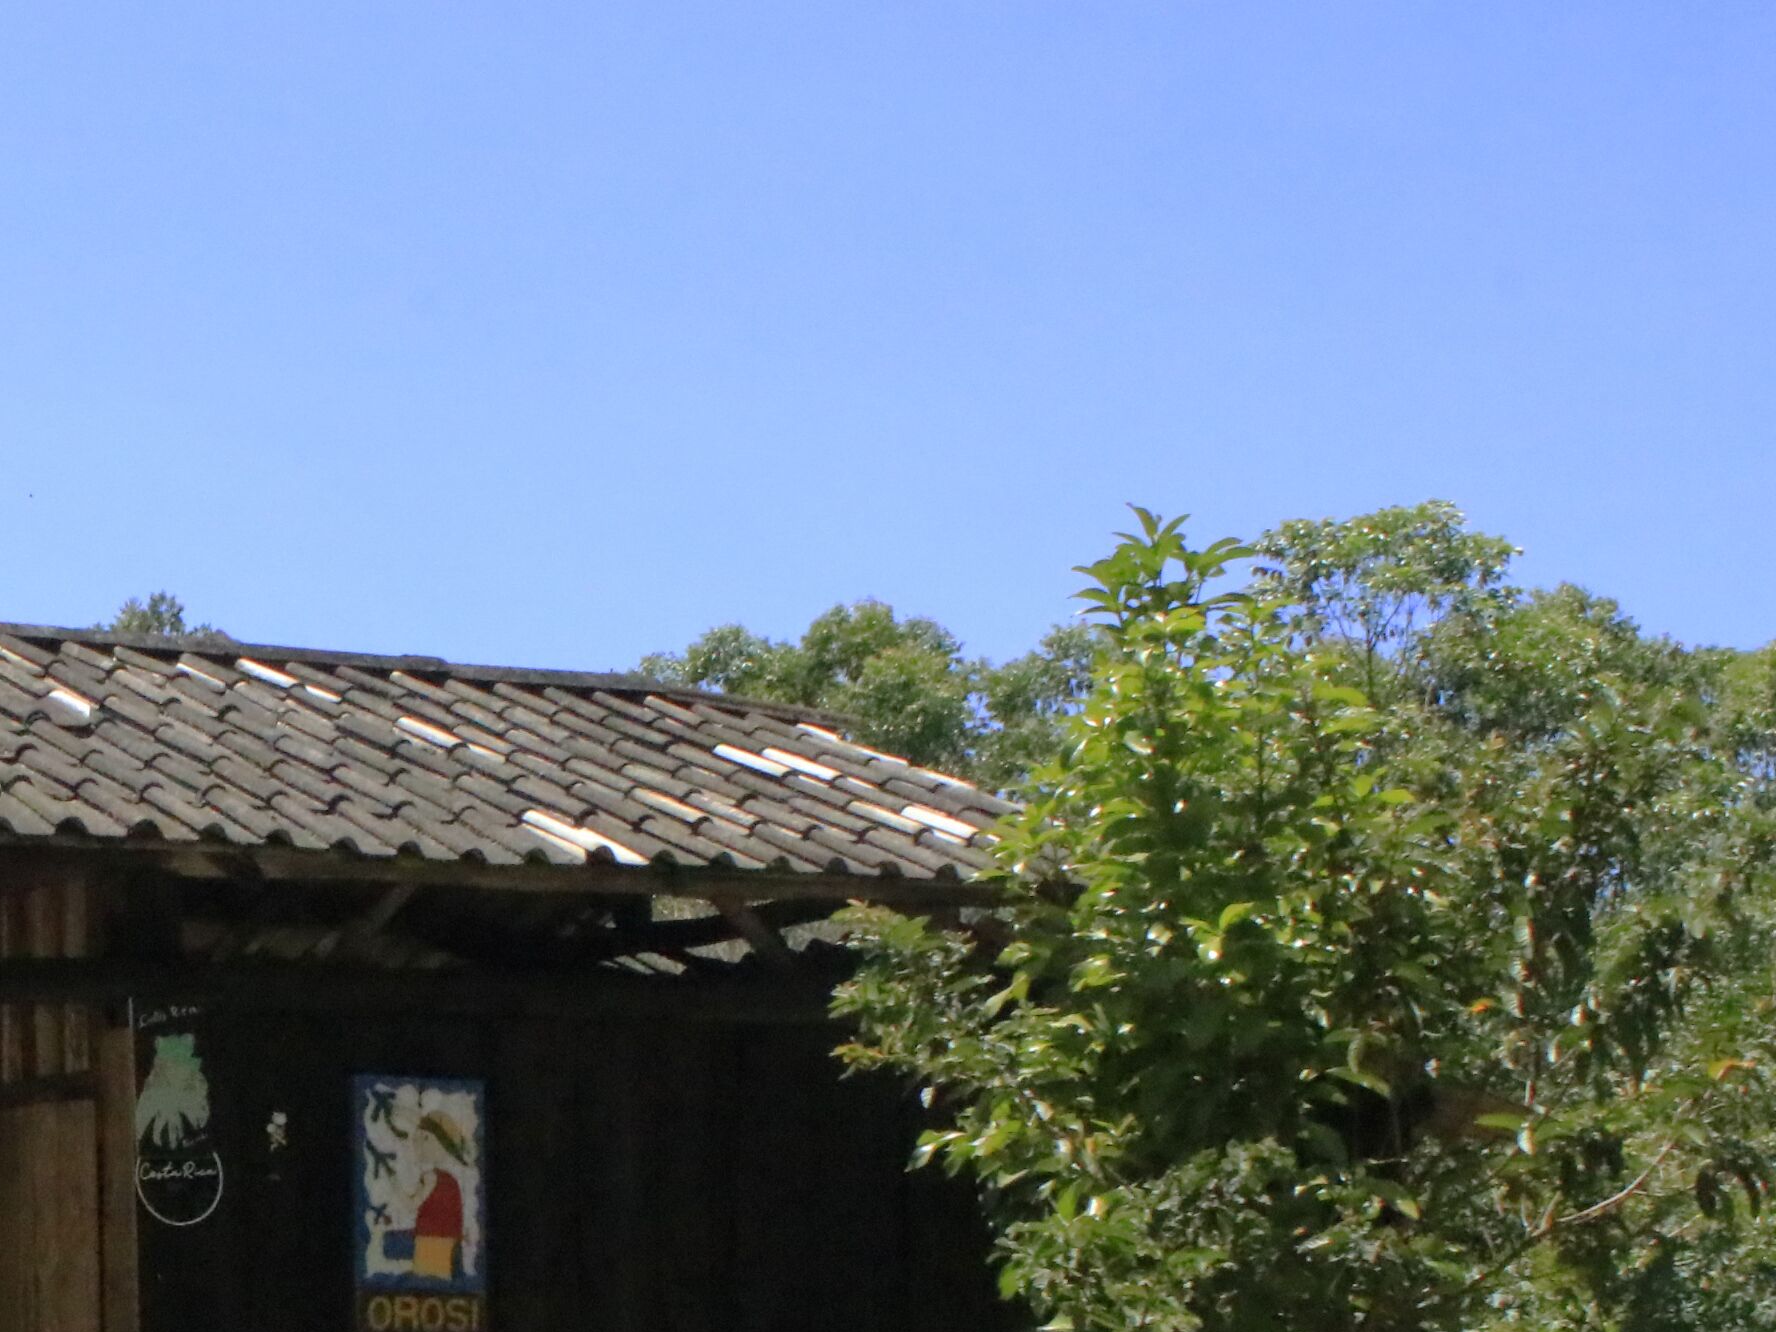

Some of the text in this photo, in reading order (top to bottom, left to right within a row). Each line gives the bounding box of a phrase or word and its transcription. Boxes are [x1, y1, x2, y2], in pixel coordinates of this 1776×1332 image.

[140, 1161, 217, 1181] Costa Rica
[368, 1295, 478, 1332] OROSI
